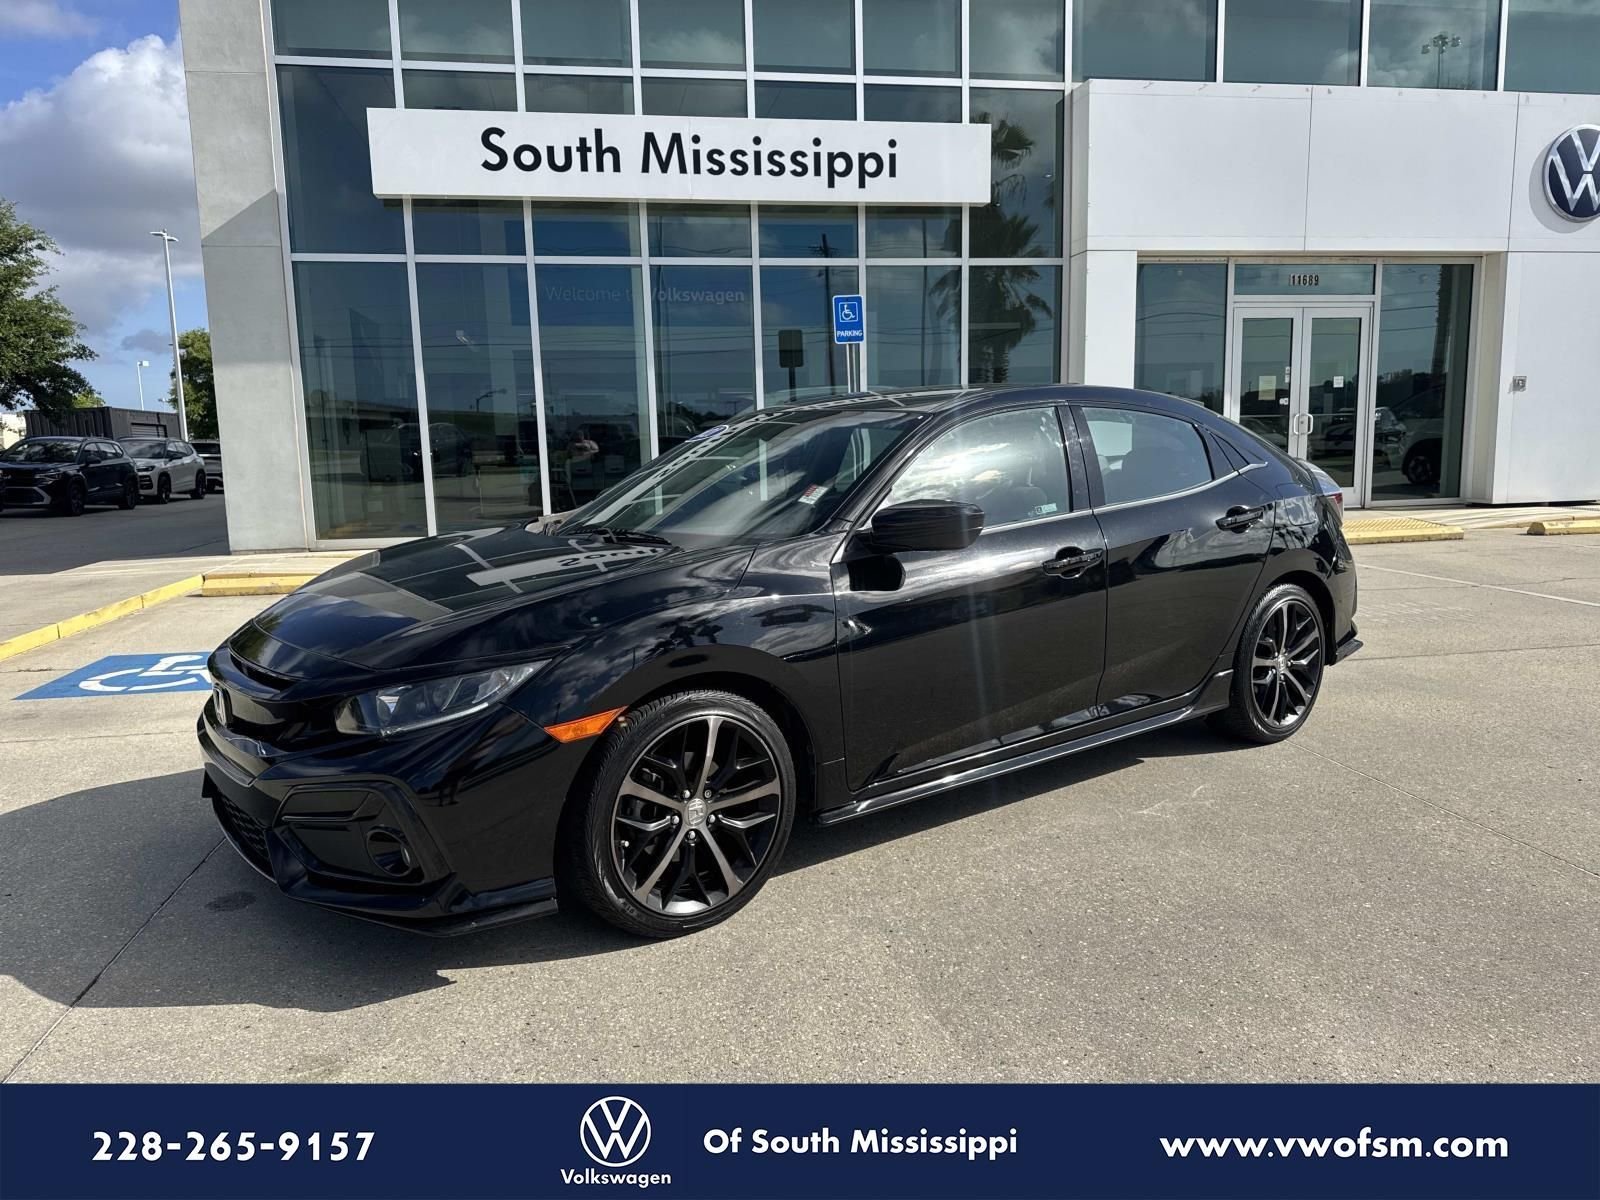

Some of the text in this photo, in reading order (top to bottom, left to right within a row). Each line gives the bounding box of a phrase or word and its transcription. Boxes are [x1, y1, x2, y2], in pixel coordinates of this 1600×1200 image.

[480, 127, 897, 189] South Mississippi
[1292, 274, 1319, 286] 11689
[546, 287, 622, 302] Welcome
